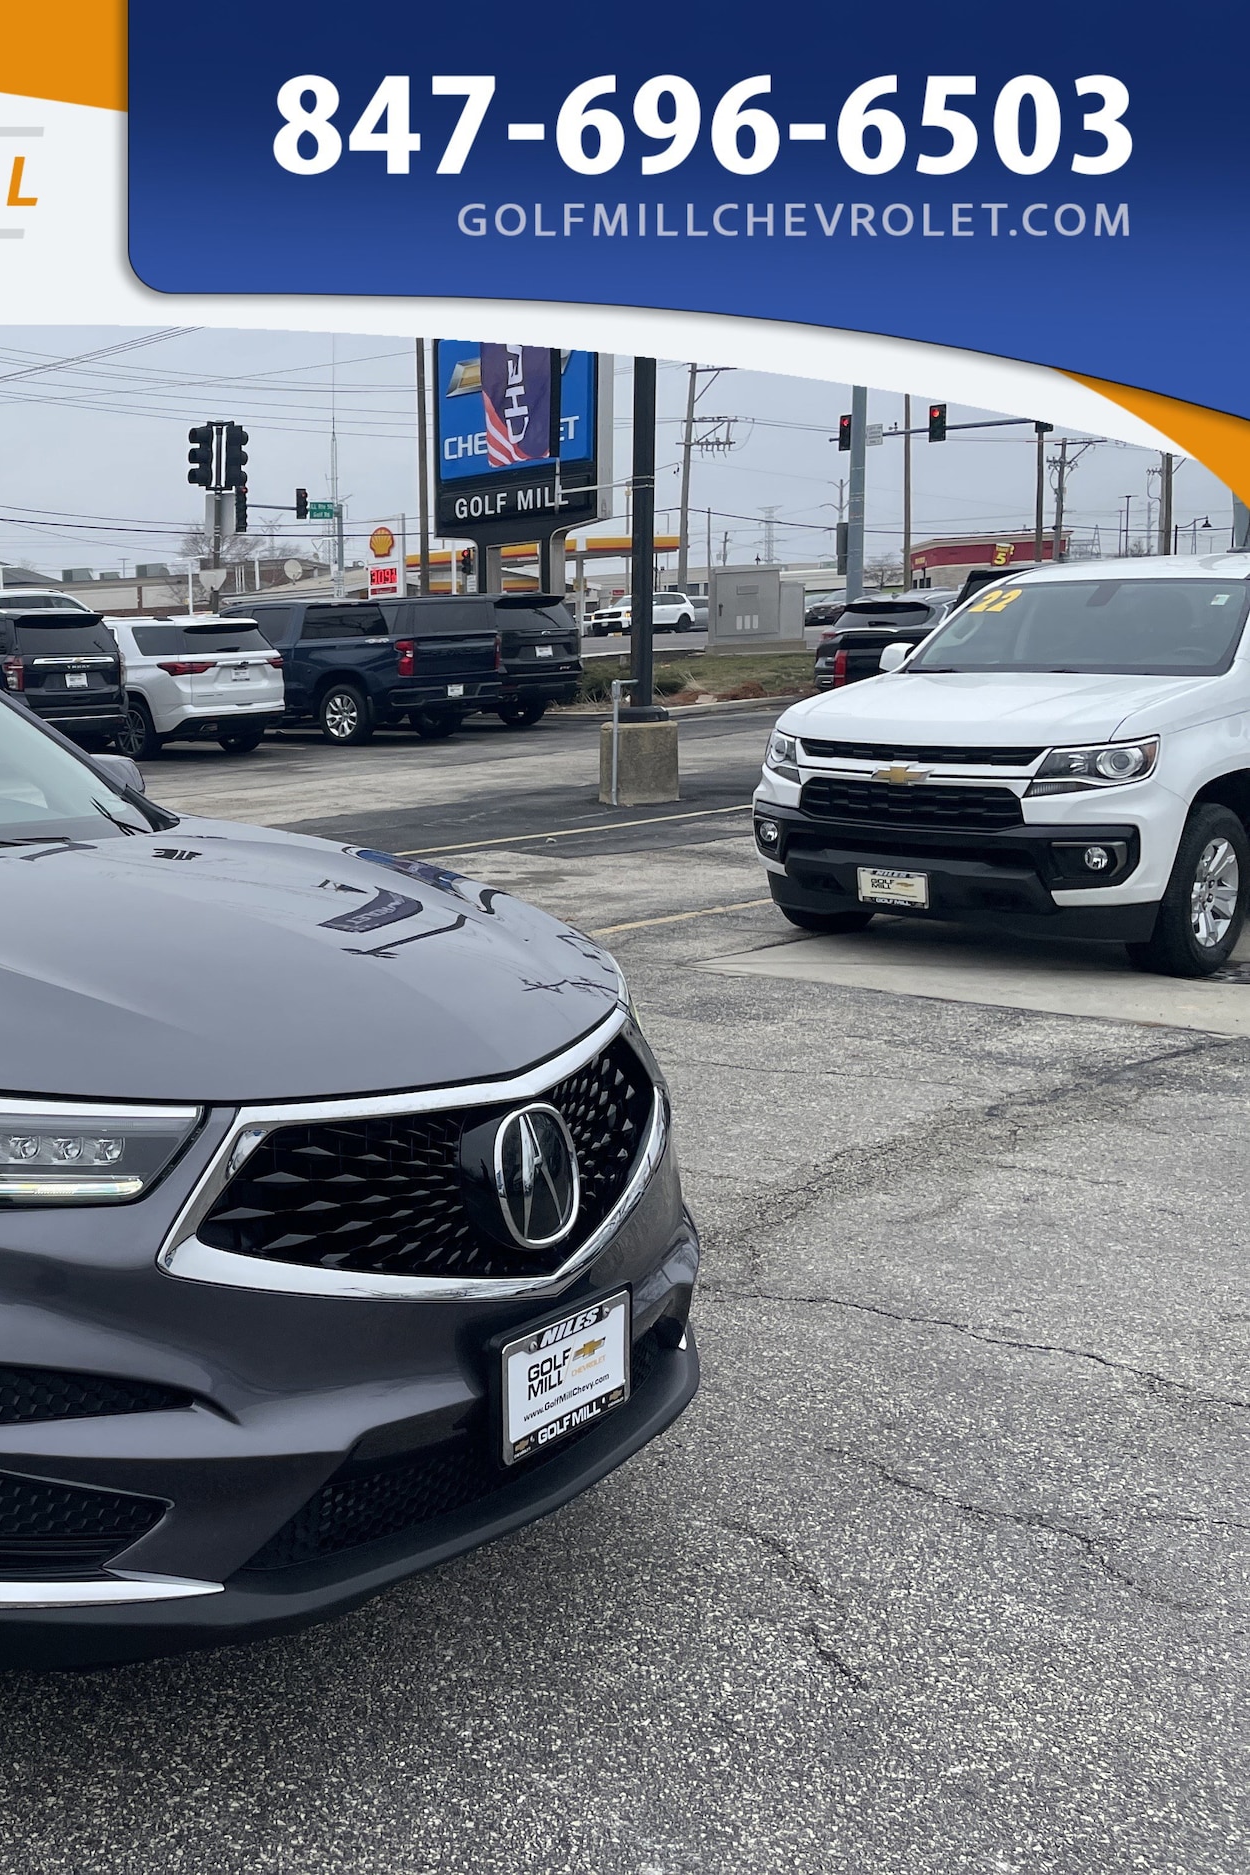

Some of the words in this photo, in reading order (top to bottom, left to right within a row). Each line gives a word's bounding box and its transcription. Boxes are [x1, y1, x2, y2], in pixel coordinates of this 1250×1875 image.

[455, 492, 507, 519] GOLF
[517, 485, 569, 511] MILL
[967, 589, 1022, 612] 22
[540, 1307, 600, 1349] NILES
[527, 1347, 572, 1382] GOLF
[571, 1354, 607, 1377] CHEVROLET
[523, 1373, 610, 1422] www.GolfMillChevy.com
[527, 1370, 563, 1401] MILL
[537, 1414, 572, 1445] GOLF
[571, 1401, 601, 1427] MILL
